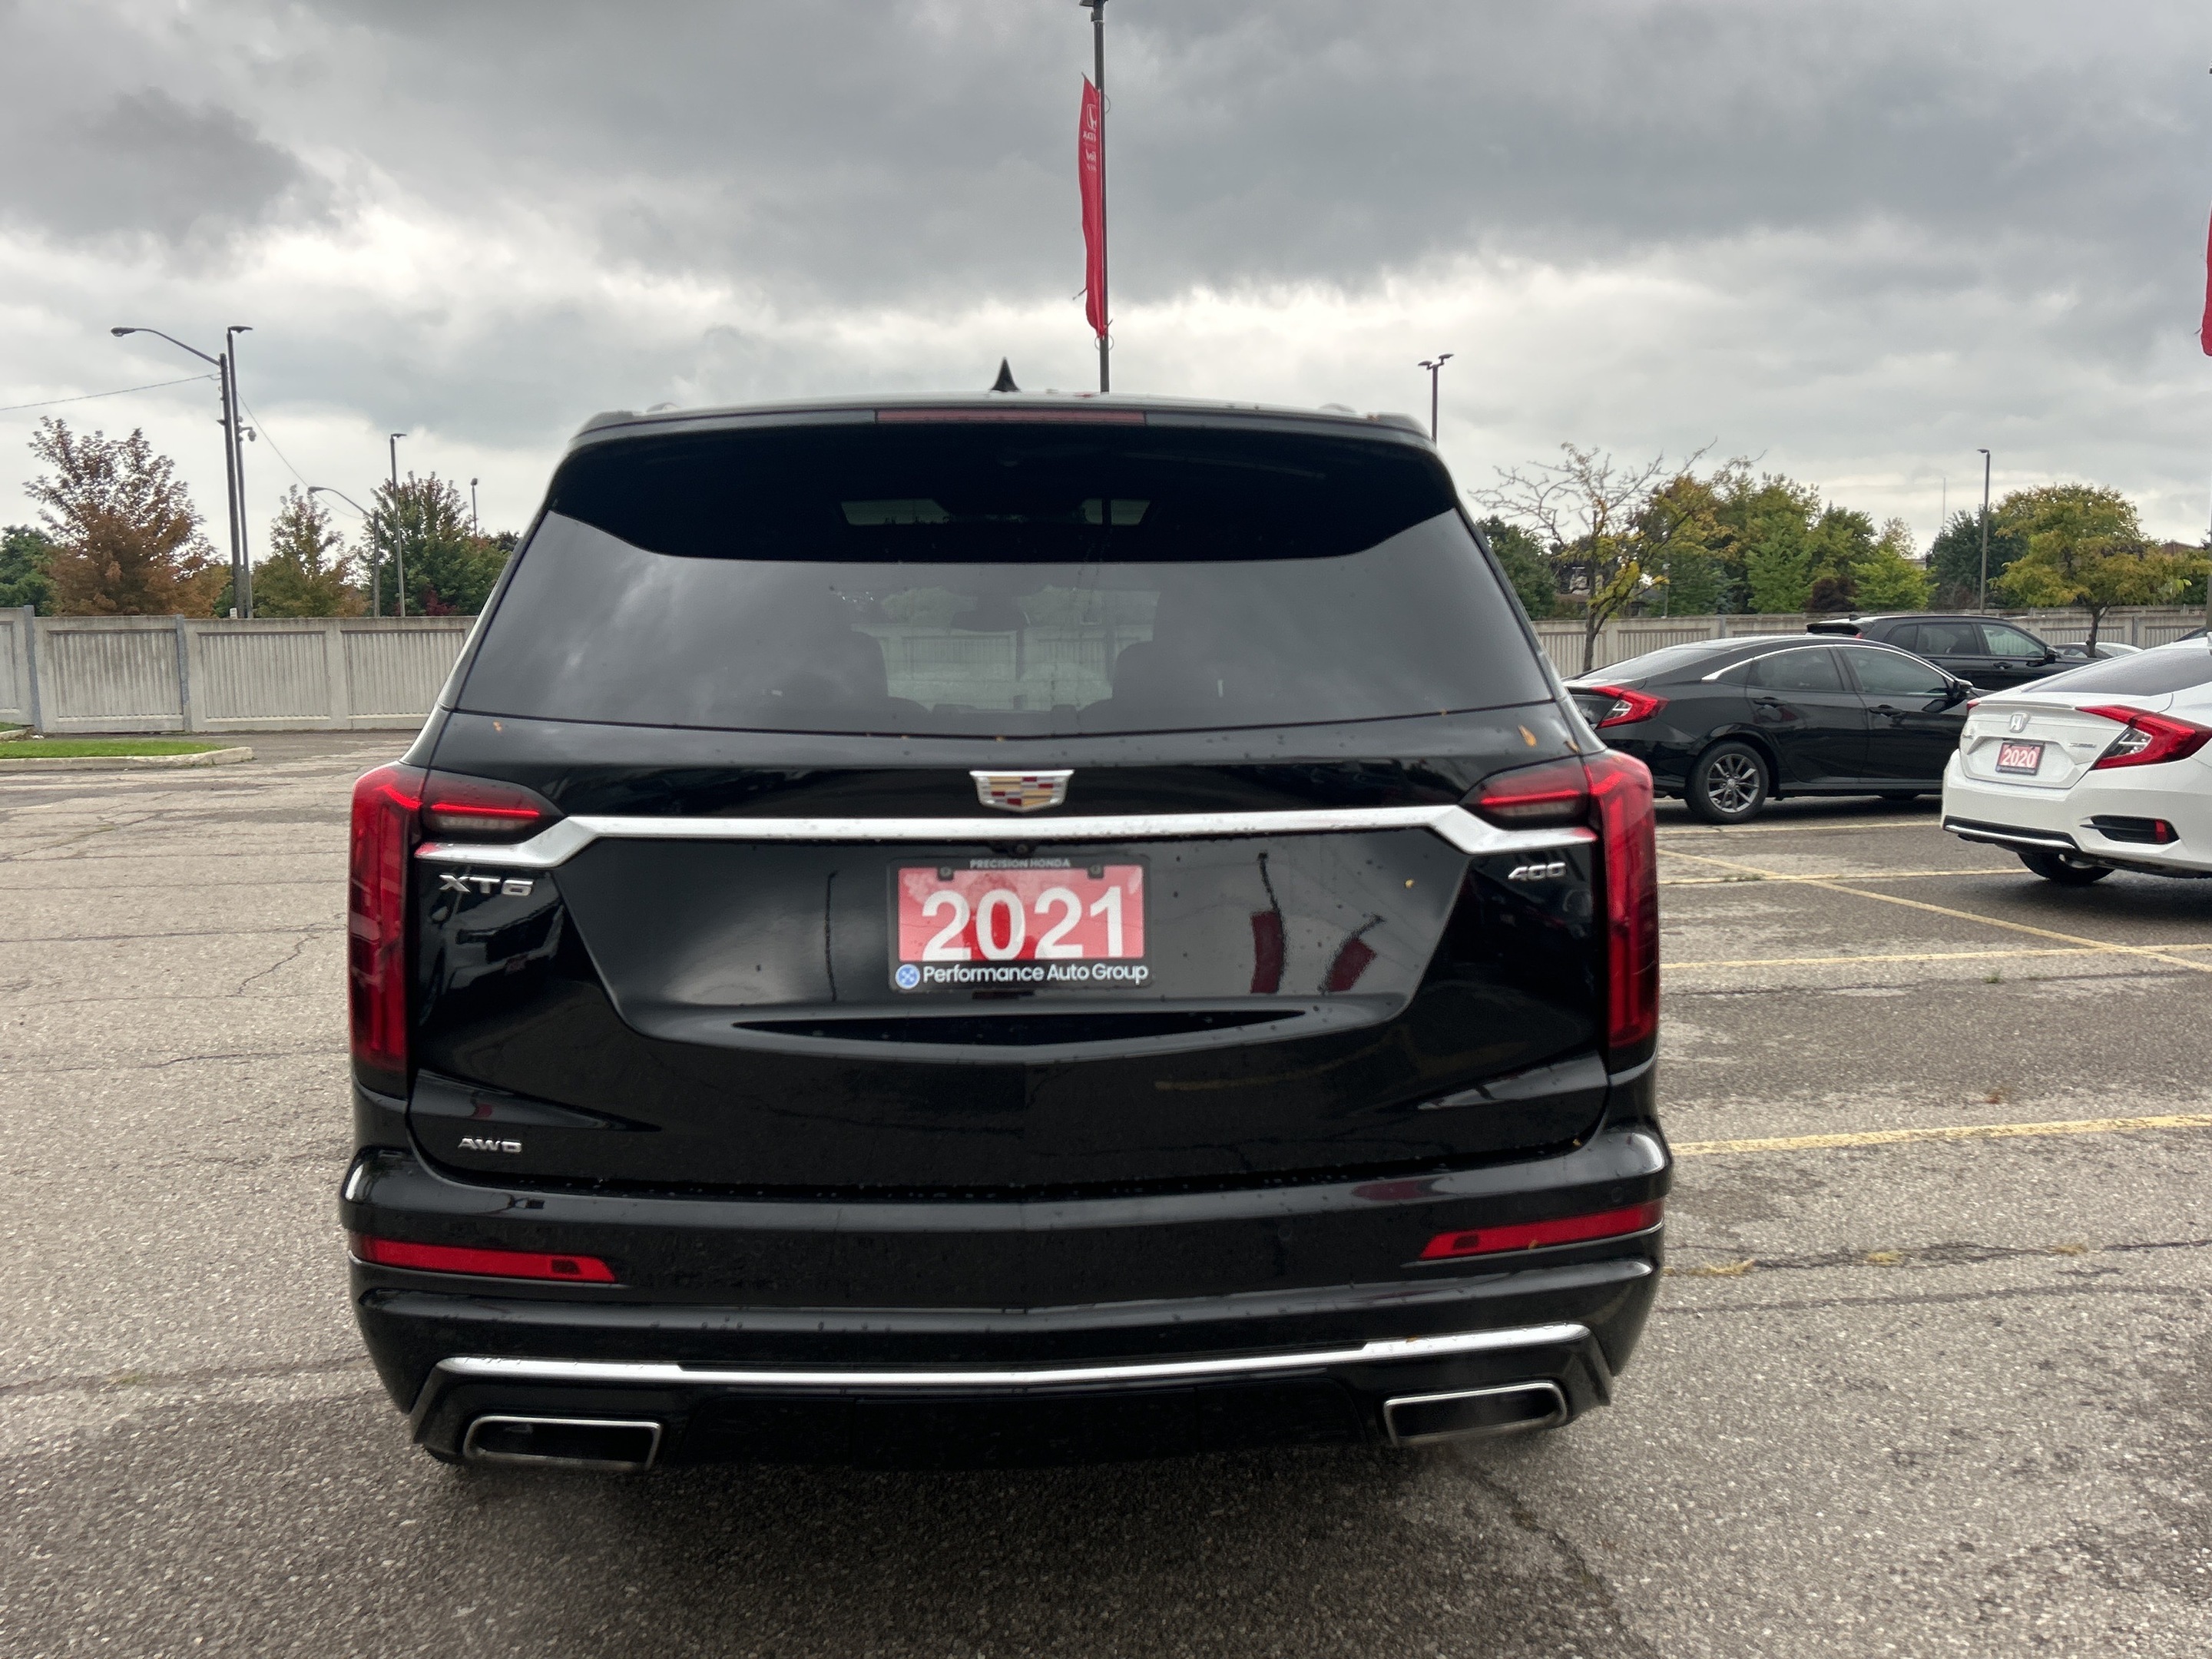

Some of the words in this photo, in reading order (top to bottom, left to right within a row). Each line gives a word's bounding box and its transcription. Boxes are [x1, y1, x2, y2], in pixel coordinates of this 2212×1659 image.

[2002, 749, 2035, 768] 2020
[969, 859, 1028, 869] PRECISION
[1030, 858, 1071, 868] HONDA
[1508, 862, 1566, 880] 400
[439, 873, 534, 896] XT6
[922, 886, 1122, 962] 2021
[923, 964, 1044, 983] Performance
[1047, 964, 1090, 981] Auto
[1091, 963, 1149, 985] Group
[457, 1137, 522, 1153] AWD
